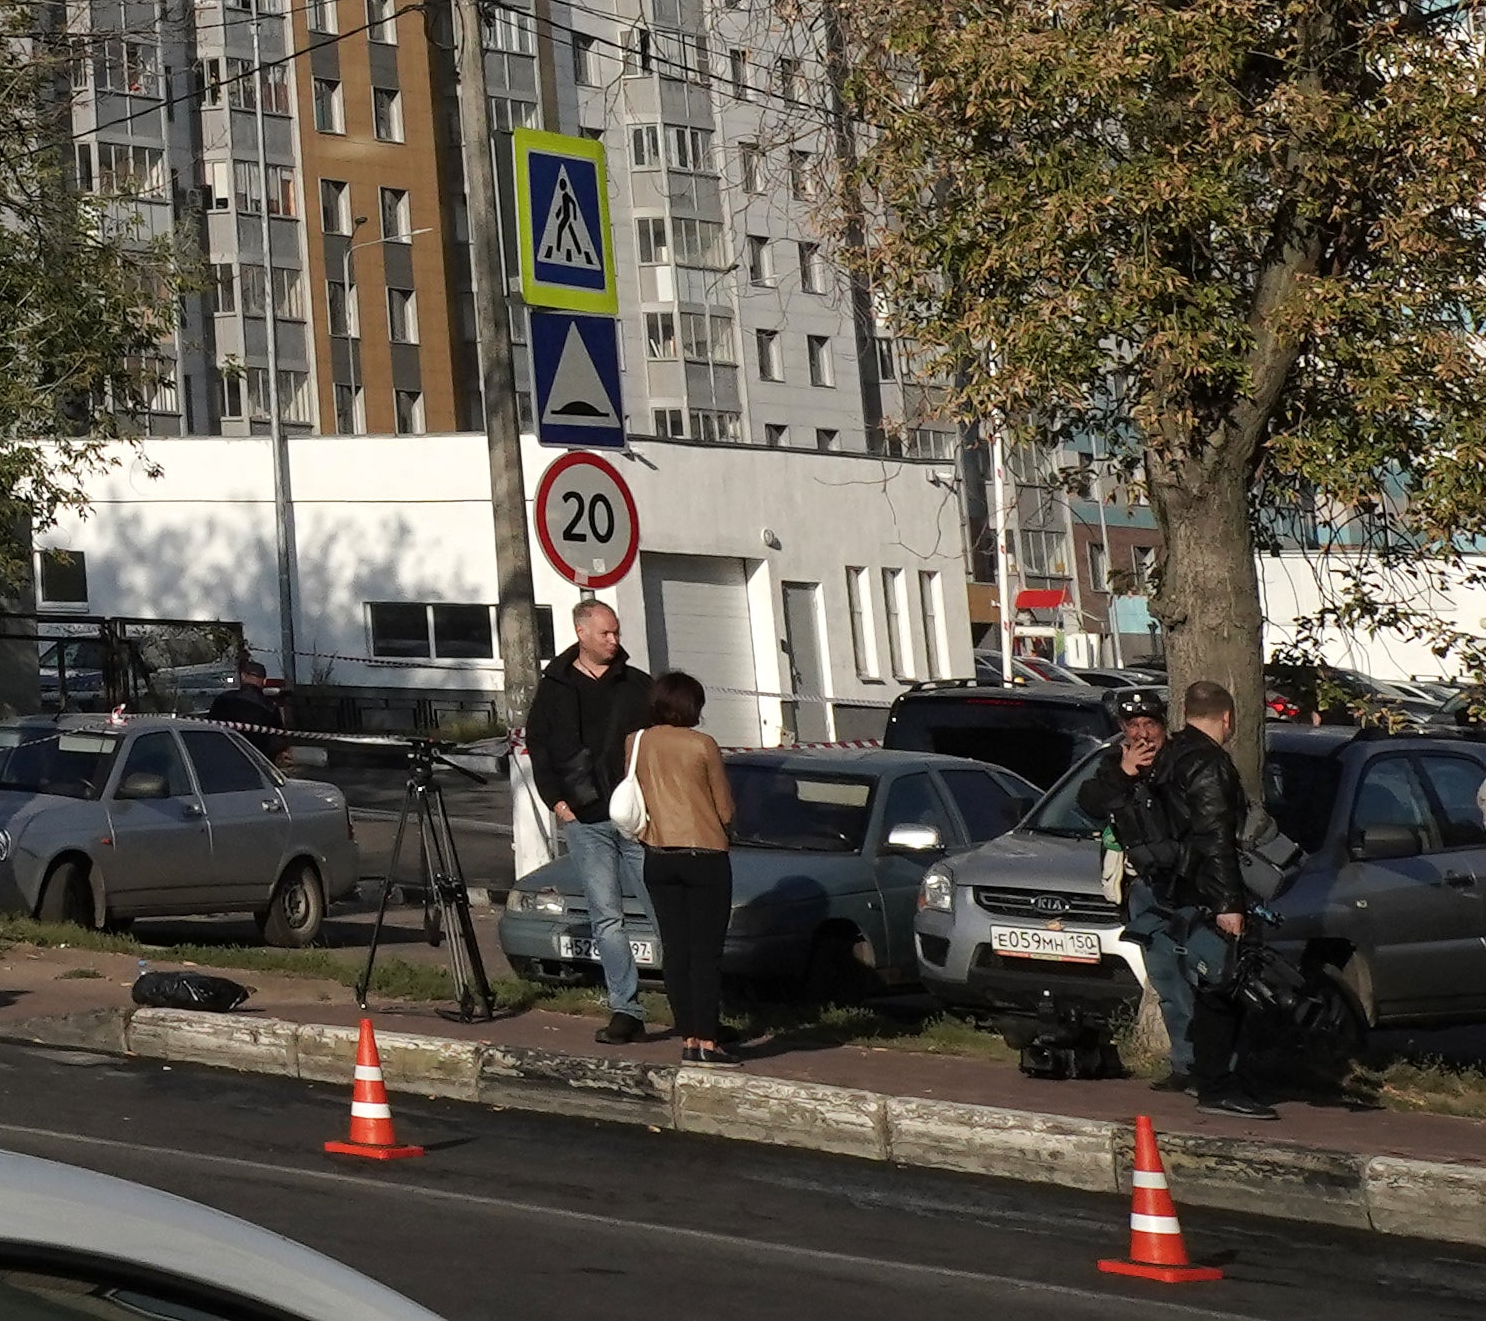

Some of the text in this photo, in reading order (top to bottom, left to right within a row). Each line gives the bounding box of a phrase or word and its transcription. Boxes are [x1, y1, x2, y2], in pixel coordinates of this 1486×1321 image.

[562, 491, 615, 544] 20
[1037, 898, 1062, 910] KIA
[998, 930, 1092, 952] Е059МН 150
